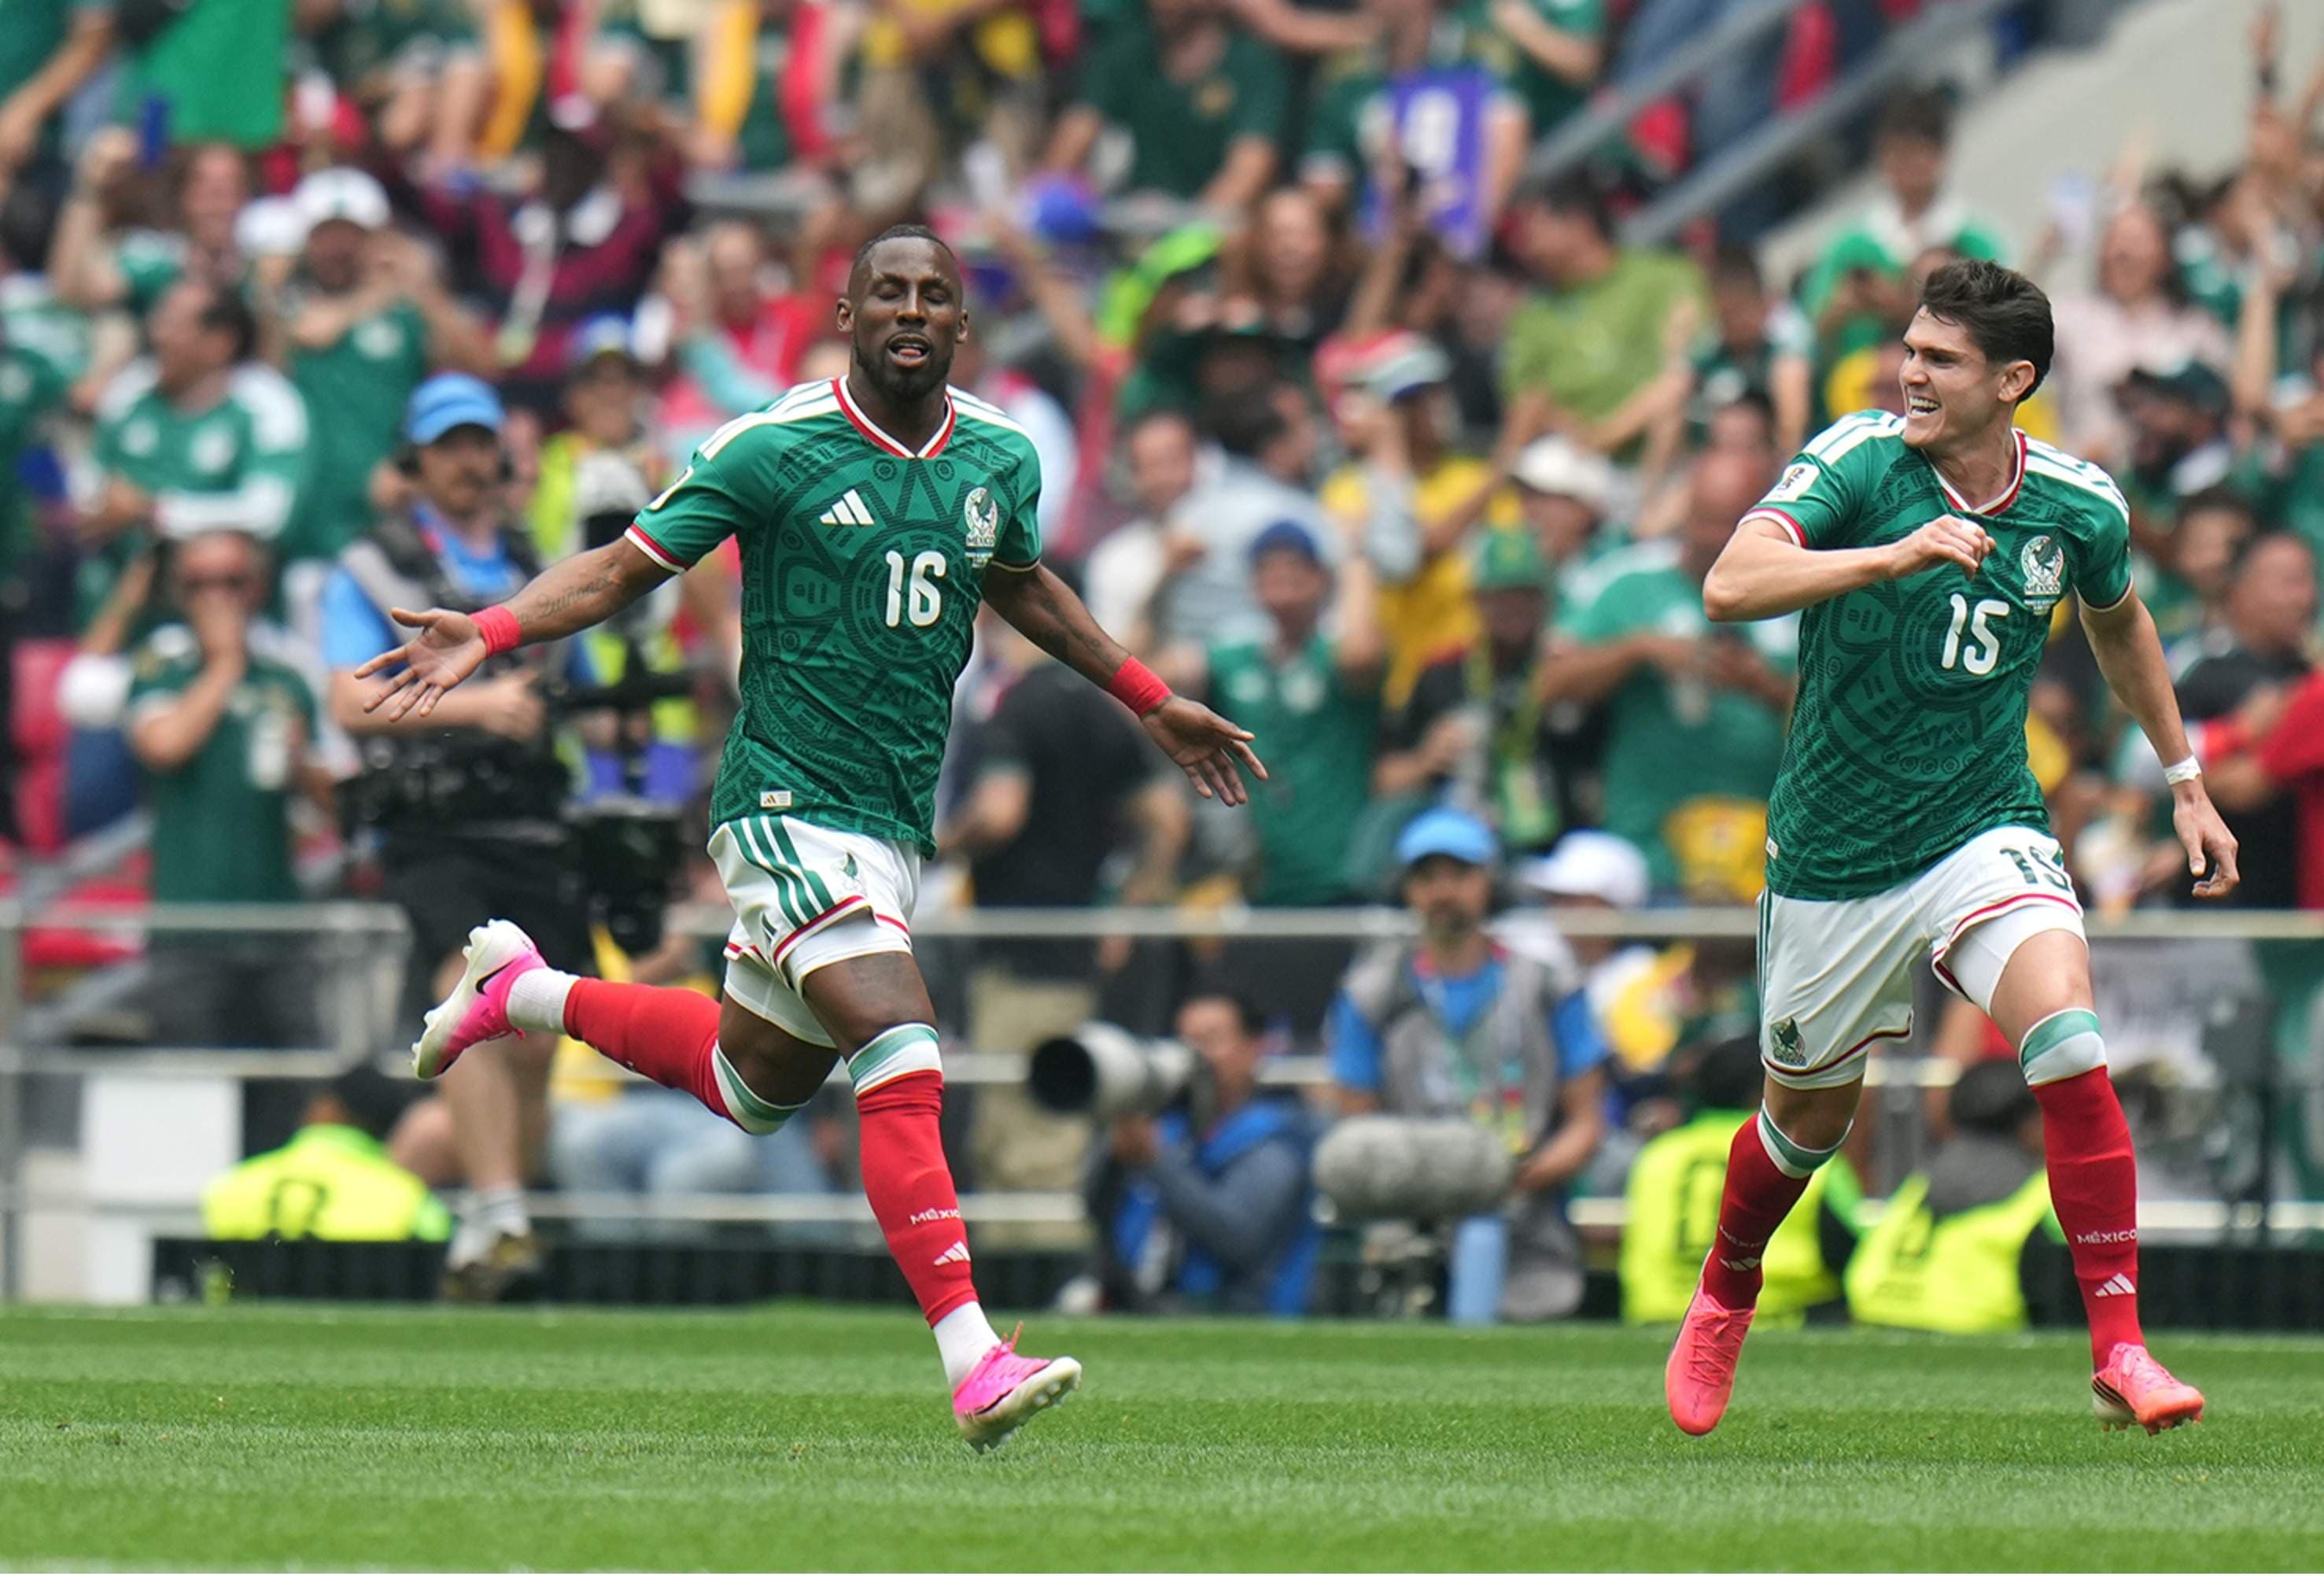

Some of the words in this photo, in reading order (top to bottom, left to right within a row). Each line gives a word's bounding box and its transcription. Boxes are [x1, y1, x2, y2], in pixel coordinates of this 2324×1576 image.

[885, 550, 946, 627] 16
[1941, 592, 2010, 674] 15
[2076, 1228, 2138, 1244] MÉXICO
